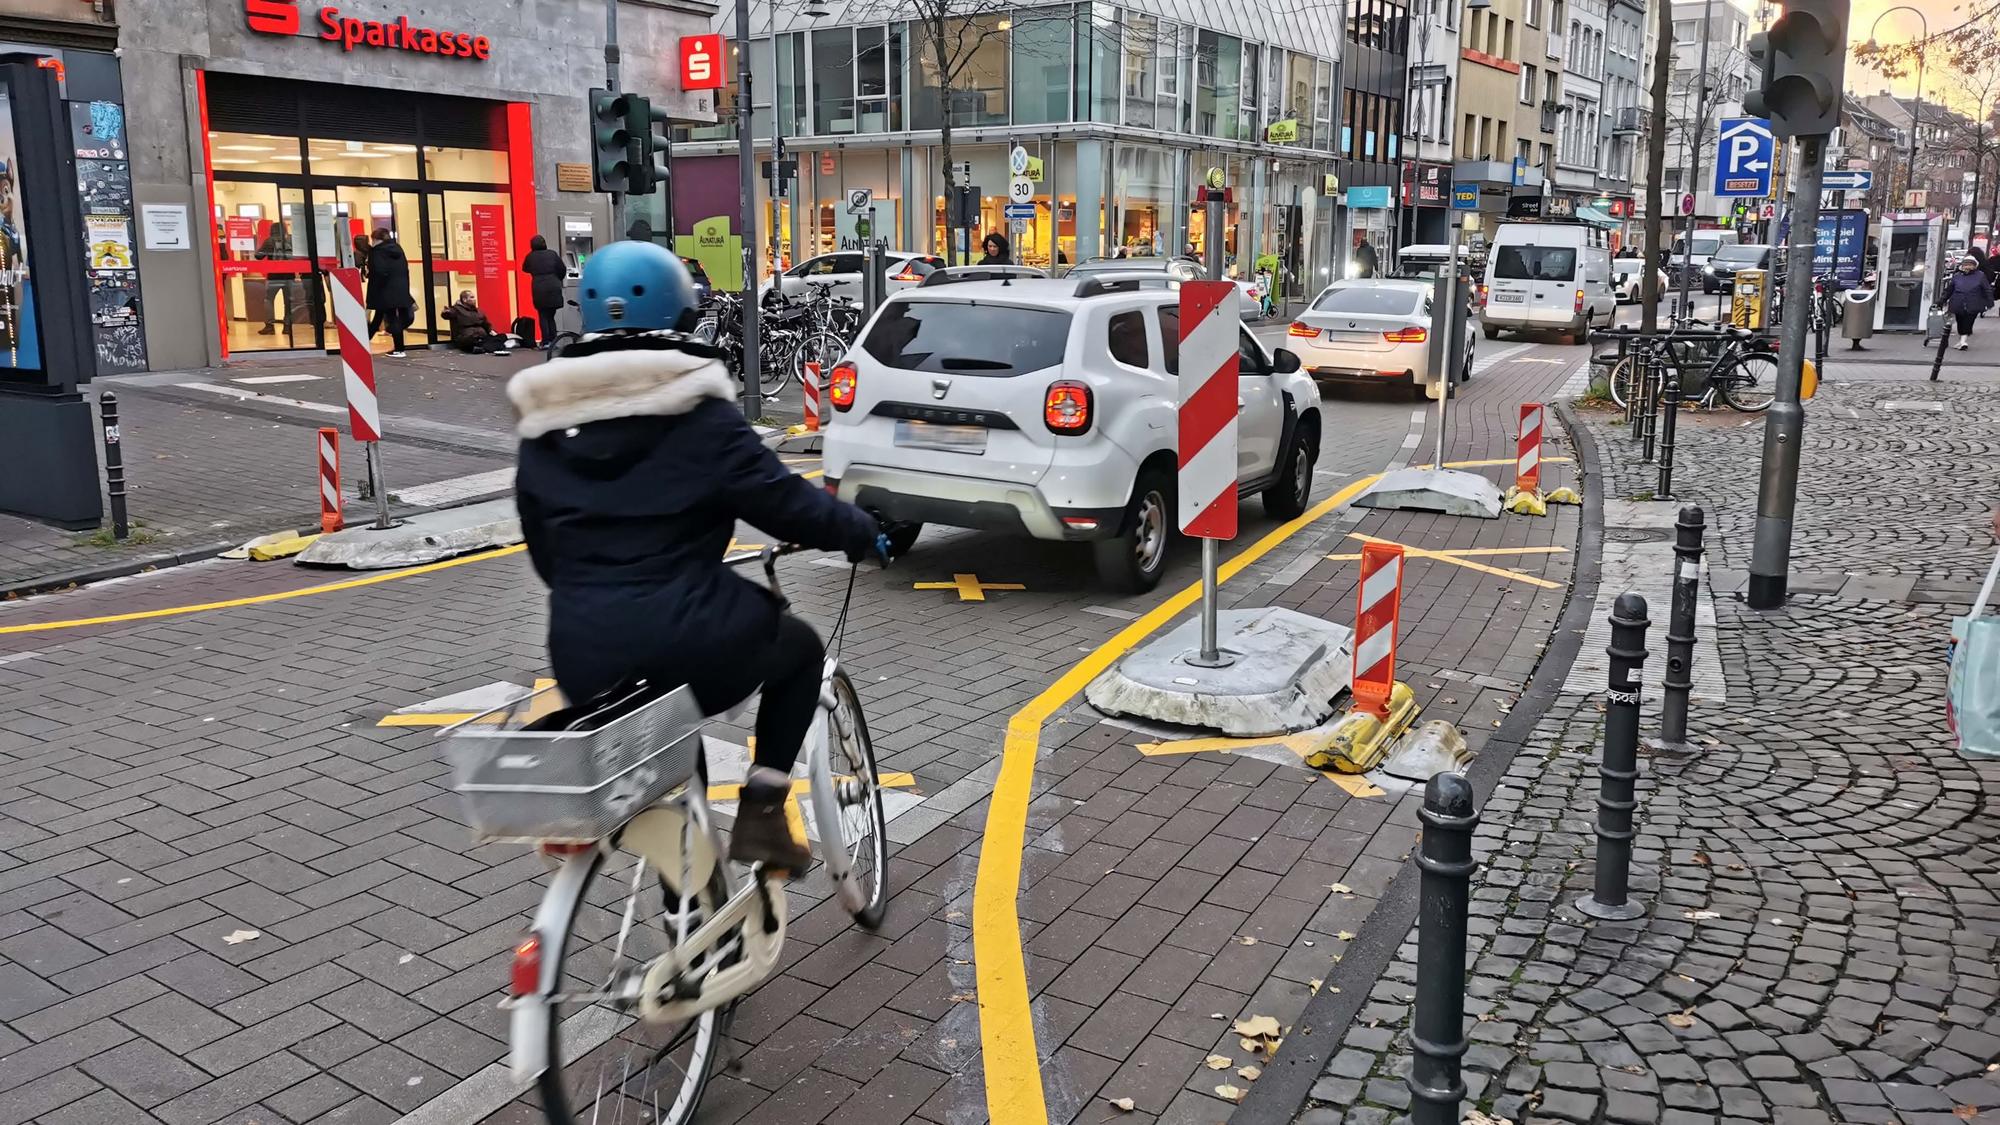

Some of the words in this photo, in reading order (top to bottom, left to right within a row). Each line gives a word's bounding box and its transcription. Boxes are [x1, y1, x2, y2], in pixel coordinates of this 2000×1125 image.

[318, 6, 491, 60] Sparkasse
[1729, 135, 1759, 173] P
[1014, 183, 1029, 196] 30
[855, 194, 865, 204] 20
[1909, 192, 1923, 207] T
[1817, 237, 1849, 245] daurt
[896, 407, 986, 422] USTER
